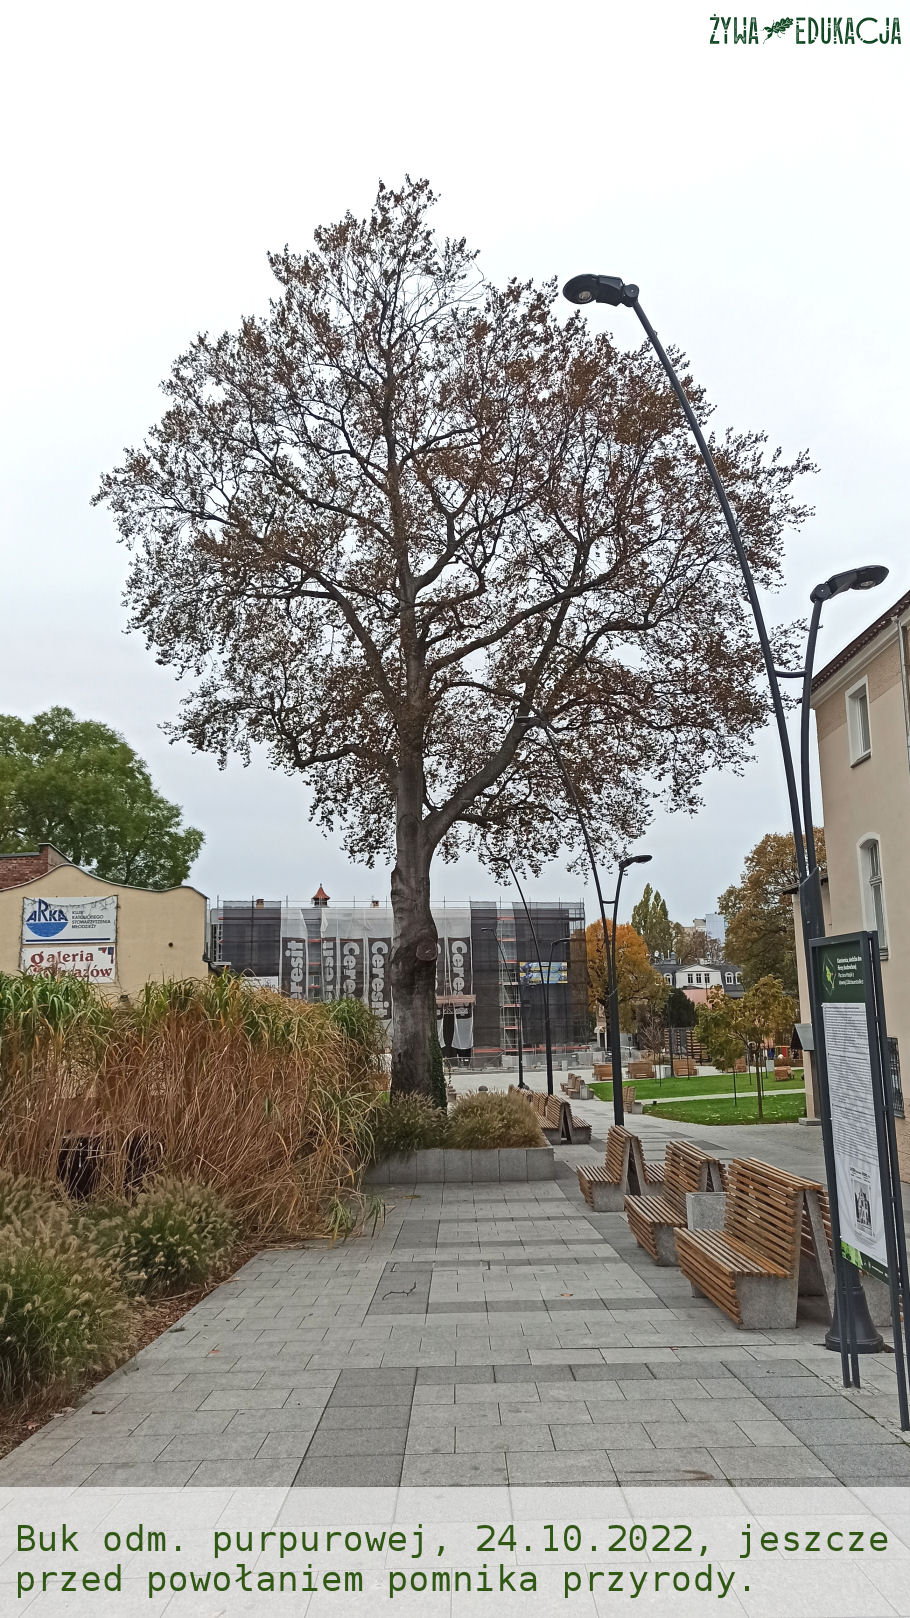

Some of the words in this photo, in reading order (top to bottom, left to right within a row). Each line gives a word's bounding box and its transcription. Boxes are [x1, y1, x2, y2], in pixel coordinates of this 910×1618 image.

[27, 898, 68, 922] ARKA
[30, 950, 94, 973] galeria
[371, 941, 390, 1018] Ceresit
